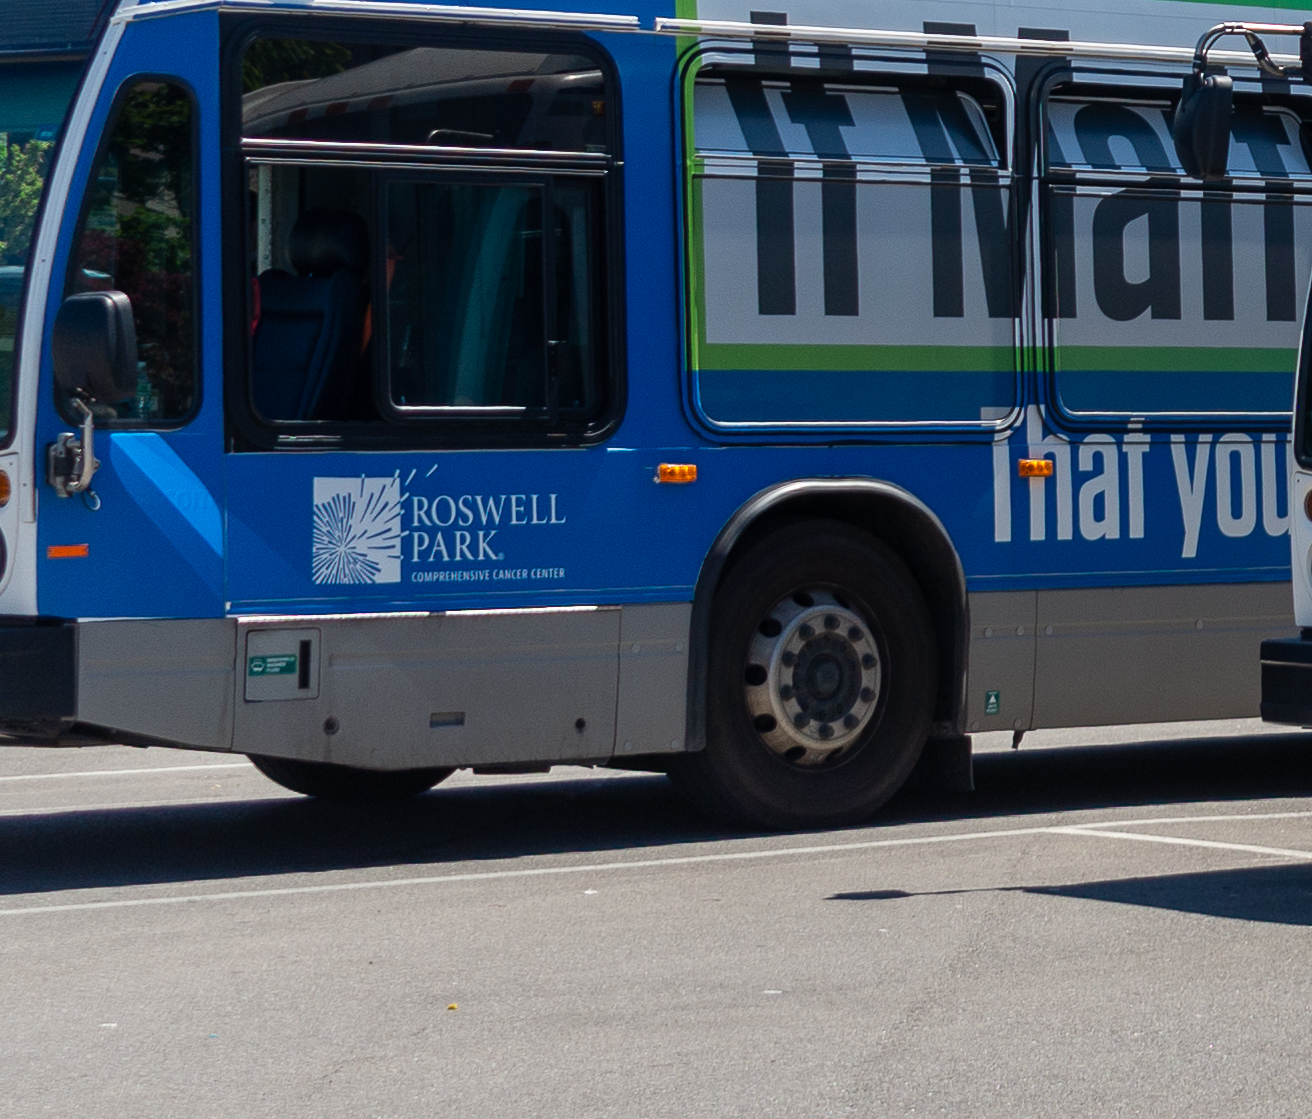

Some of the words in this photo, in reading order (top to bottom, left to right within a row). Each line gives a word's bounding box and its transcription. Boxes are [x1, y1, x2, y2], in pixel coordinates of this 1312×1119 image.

[980, 404, 1152, 542] That
[411, 493, 567, 527] ROSWELL
[411, 569, 490, 583] COMPREHENSIVE
[492, 568, 529, 580] CANCER
[531, 567, 566, 579] CENTER
